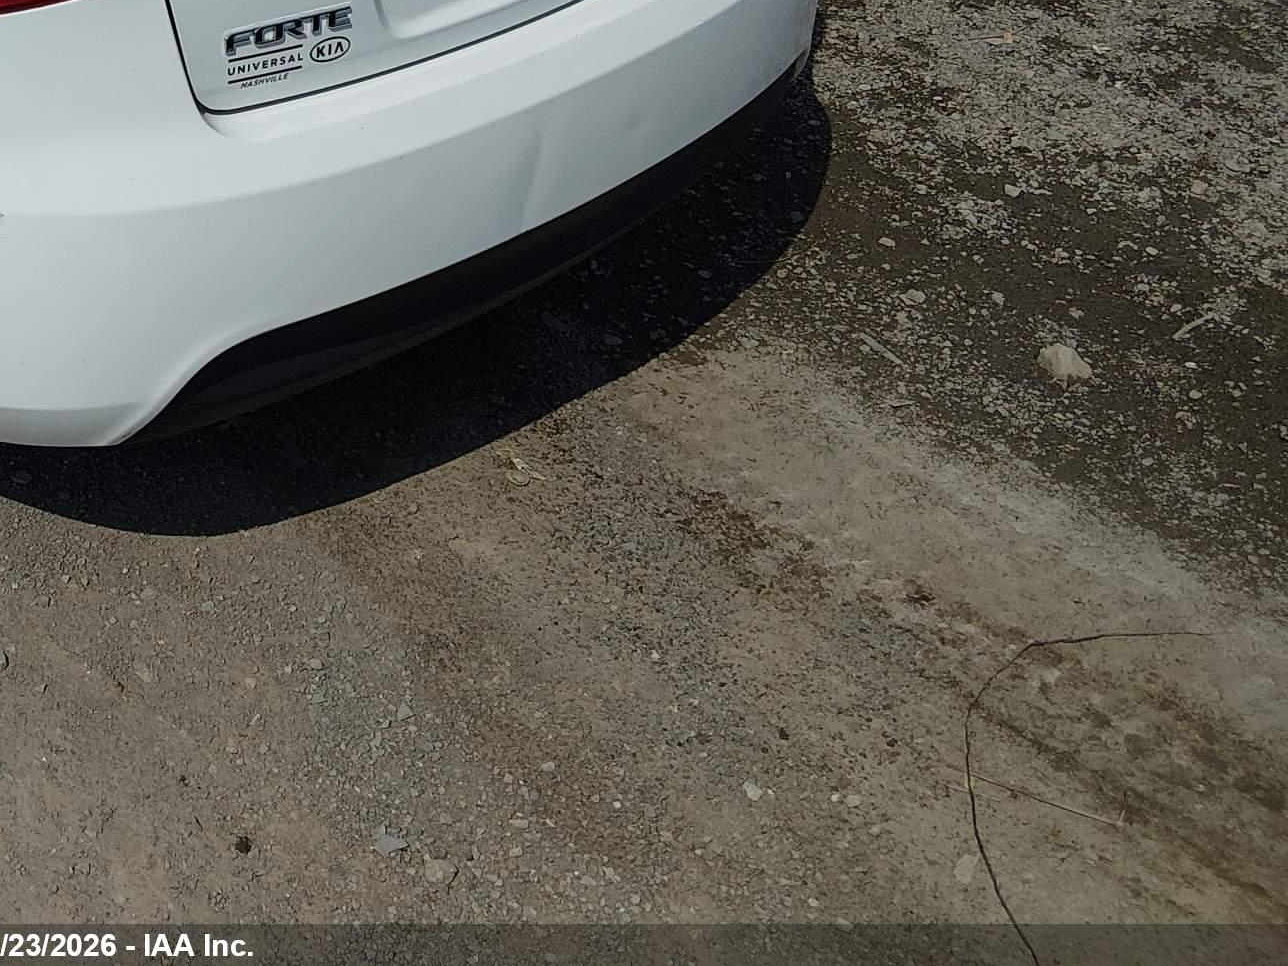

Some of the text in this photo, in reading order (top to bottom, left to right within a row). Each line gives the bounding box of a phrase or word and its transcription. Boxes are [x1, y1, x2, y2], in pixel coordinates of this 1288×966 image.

[224, 5, 353, 56] FORTE
[316, 41, 345, 59] KIA
[227, 52, 304, 76] UNIVERSAL
[240, 72, 289, 90] NASHVILLE
